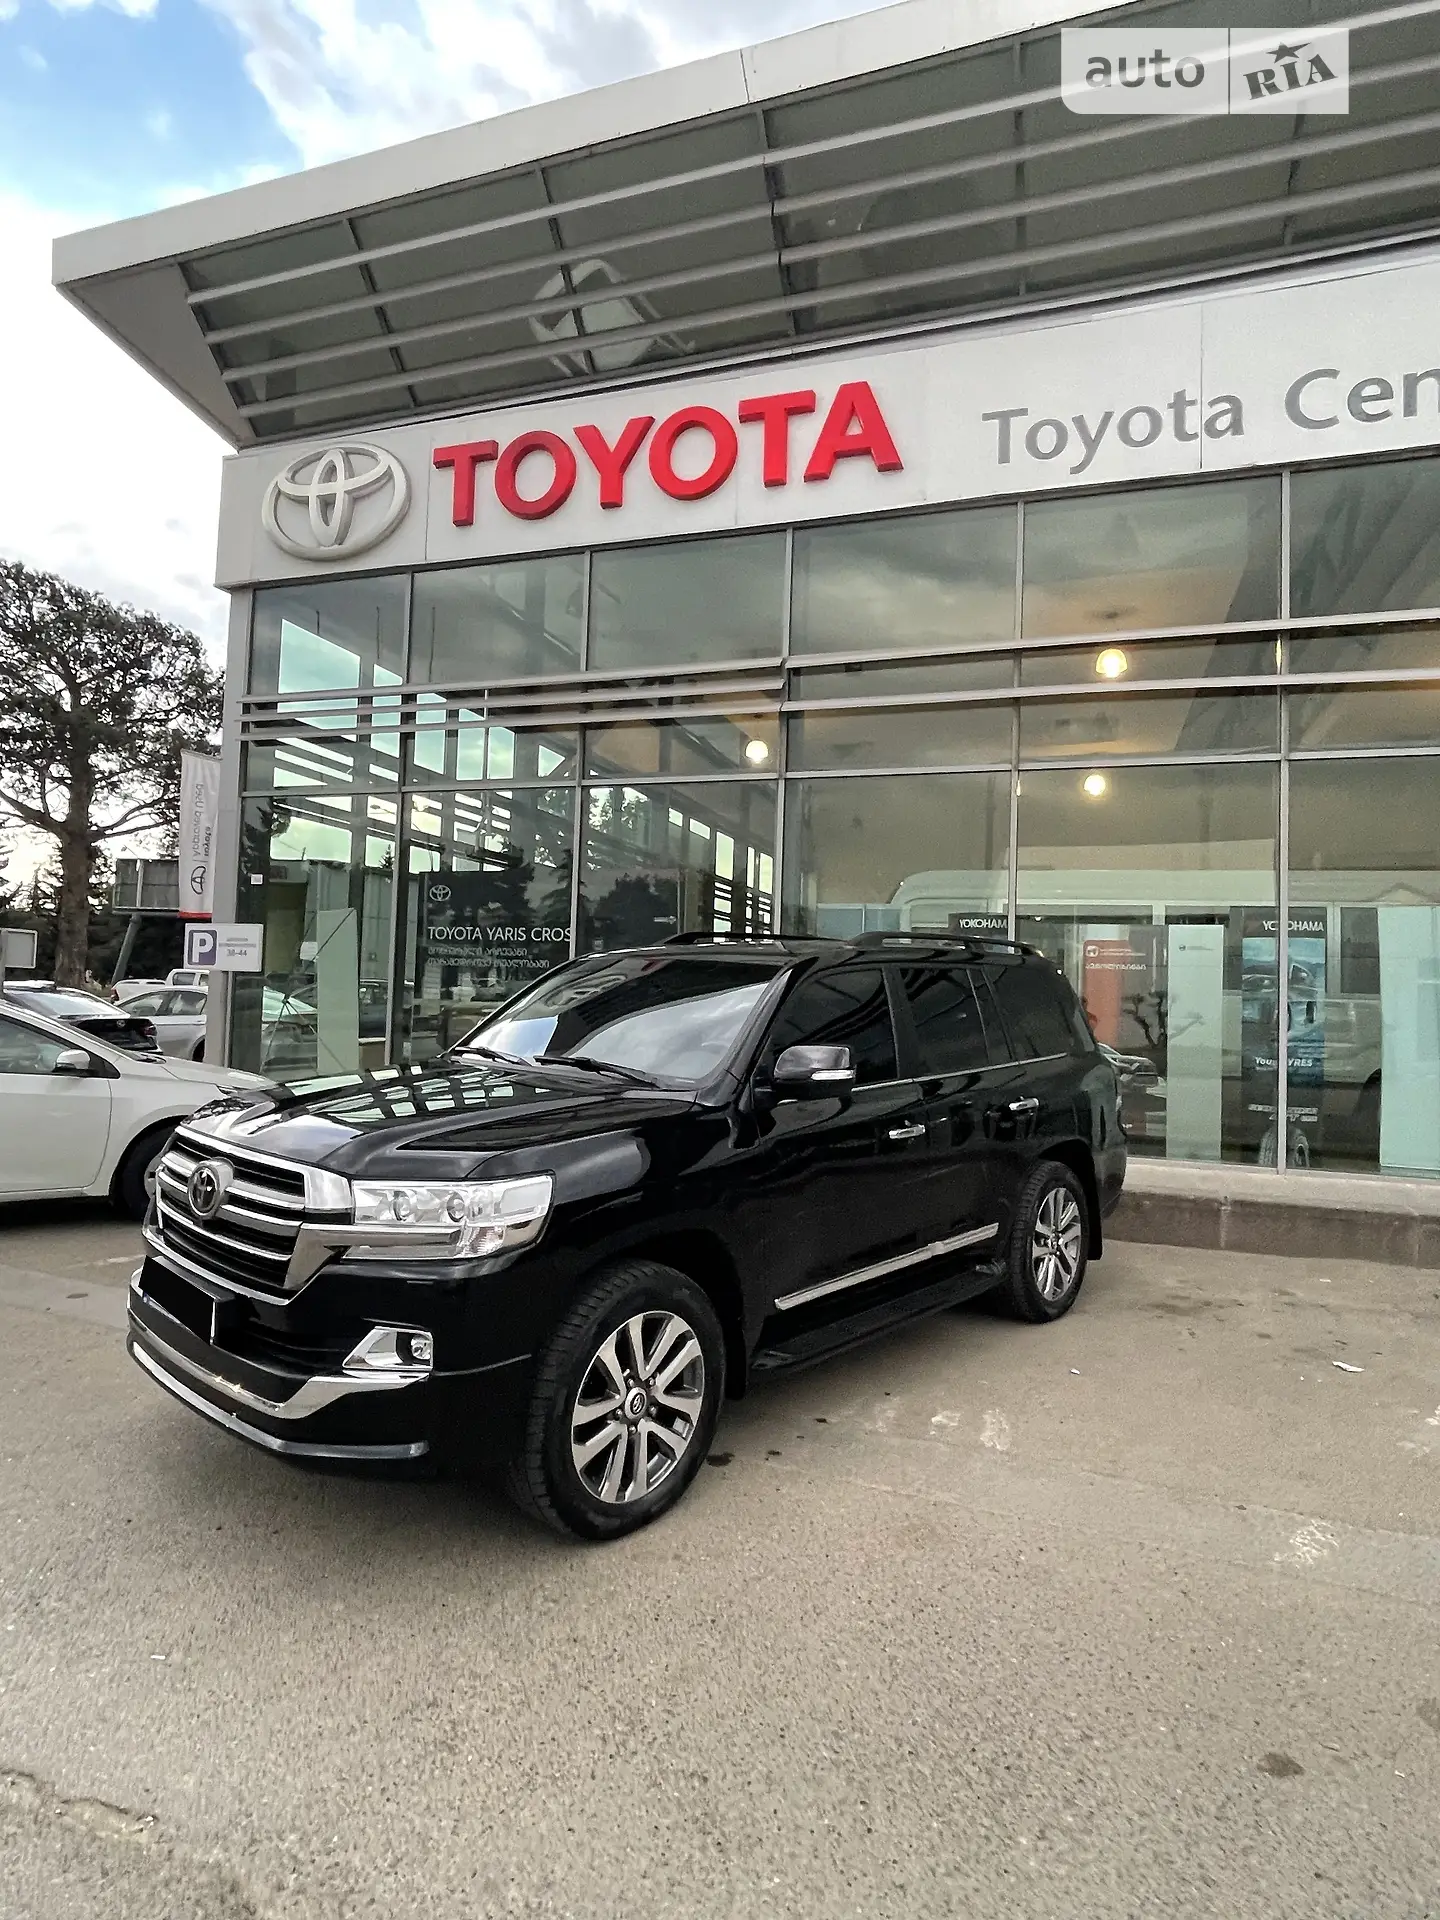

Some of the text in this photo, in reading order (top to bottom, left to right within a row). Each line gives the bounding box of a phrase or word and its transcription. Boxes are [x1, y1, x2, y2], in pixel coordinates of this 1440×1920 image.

[982, 367, 1440, 475] Toyota Cen
[432, 380, 904, 527] TOYOTA
[959, 918, 1008, 928] YOKOHAM
[1262, 920, 1324, 931] YOOHAMA
[428, 926, 571, 942] TOYOTA YARIS CROS
[192, 932, 213, 963] P
[1287, 1058, 1313, 1067] YRES
